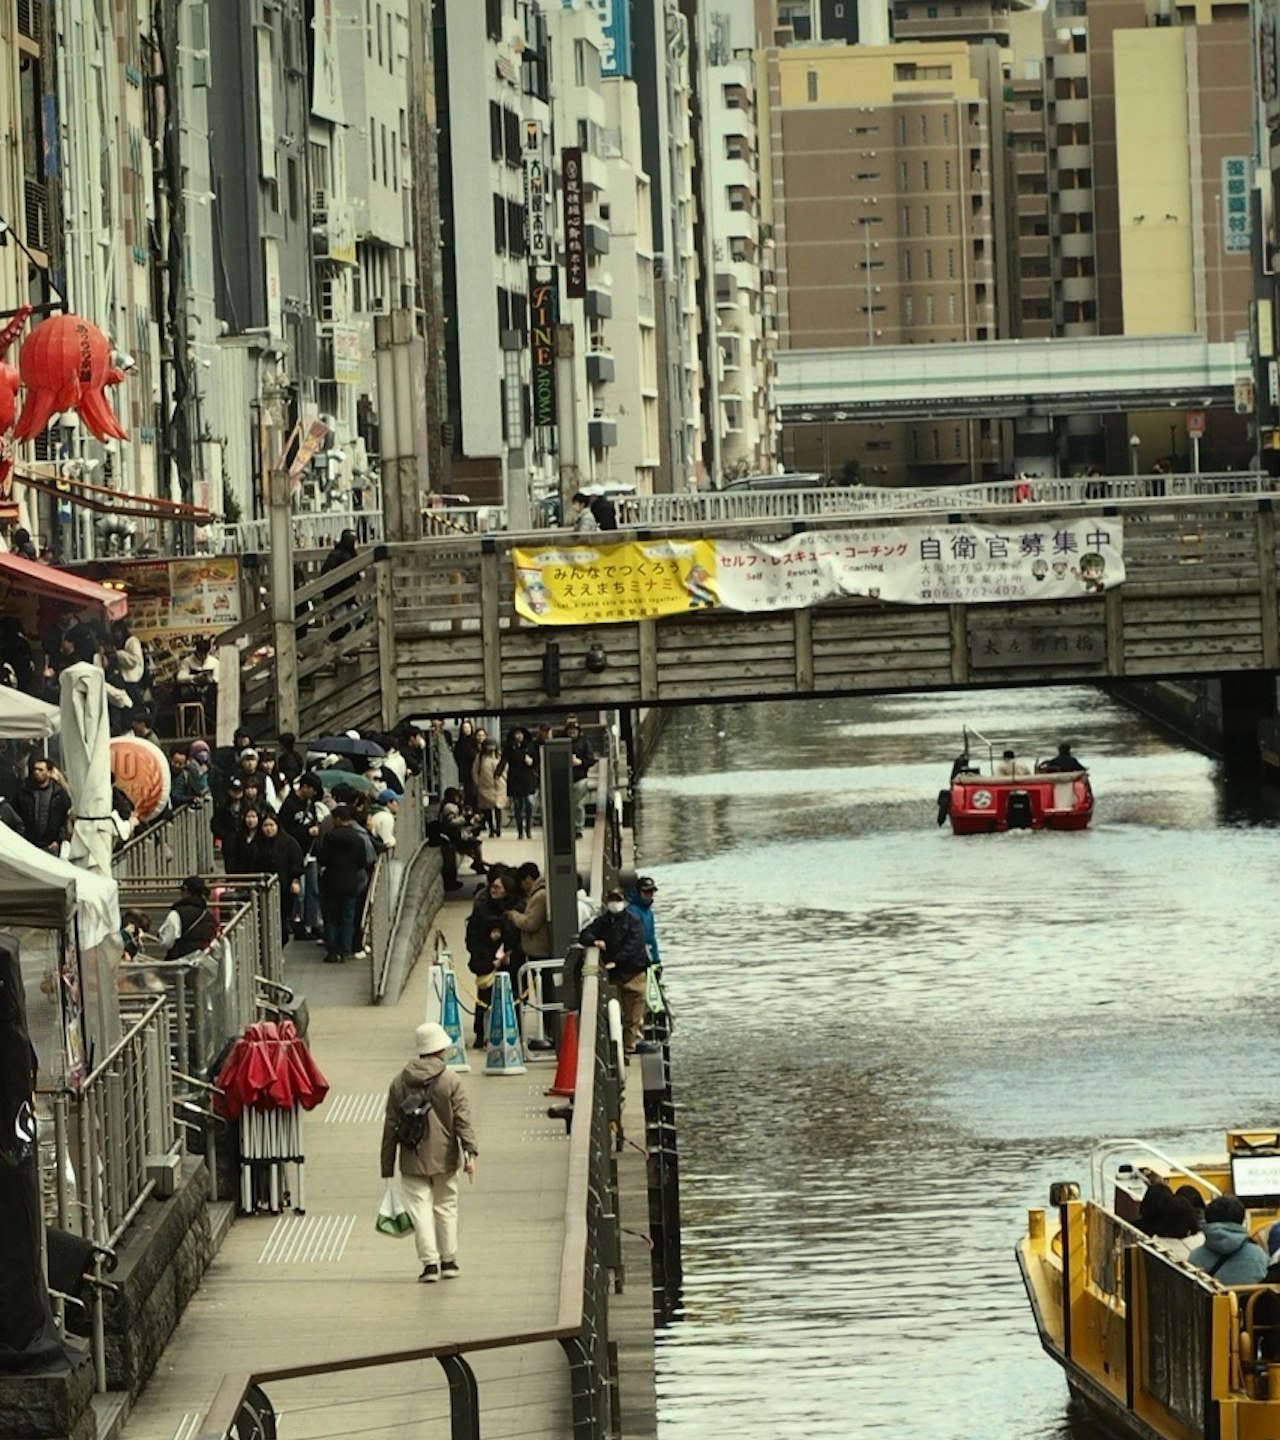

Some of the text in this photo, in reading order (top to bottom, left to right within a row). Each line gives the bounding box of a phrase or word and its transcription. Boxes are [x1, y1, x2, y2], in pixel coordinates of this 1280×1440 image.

[536, 368, 549, 426] AROMA
[920, 528, 1111, 562] 自衛官募集中
[554, 561, 681, 580] みんなでつくろう
[746, 562, 884, 582] Self Rescue Coaching
[563, 577, 673, 597] ええまちミナミ
